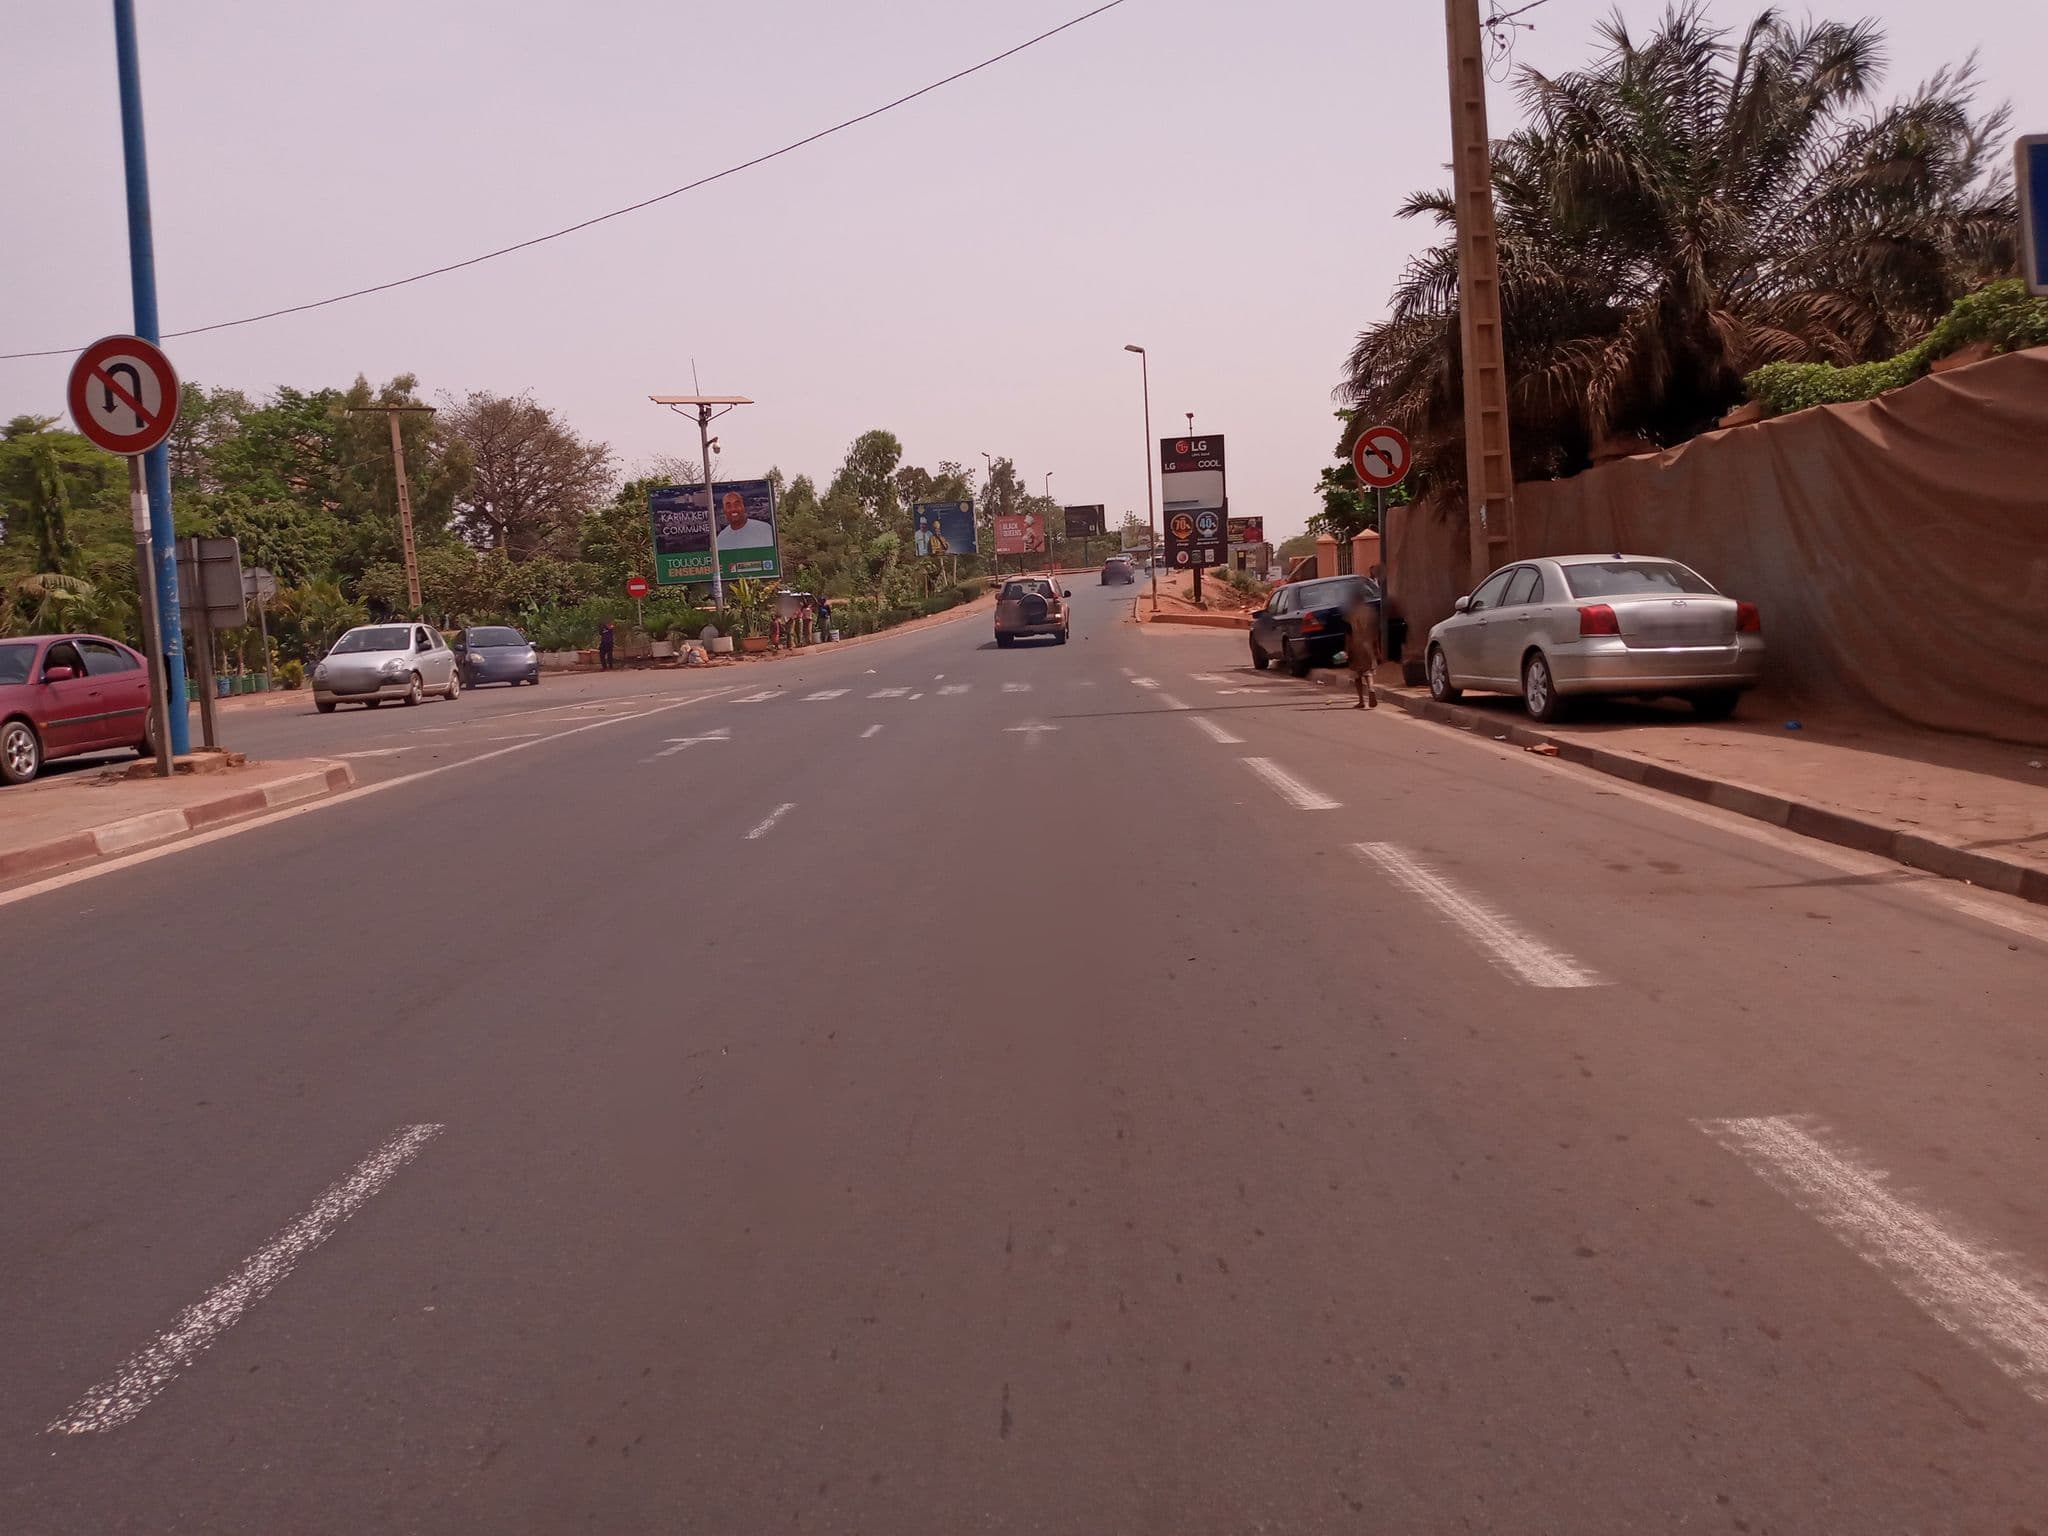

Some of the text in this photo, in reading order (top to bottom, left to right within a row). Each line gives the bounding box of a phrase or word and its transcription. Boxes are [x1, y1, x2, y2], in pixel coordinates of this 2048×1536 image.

[1191, 440, 1207, 452] LG
[1164, 459, 1222, 471] LG COOL
[691, 510, 709, 521] KEIT
[662, 523, 710, 535] COMMUNE
[666, 556, 713, 568] TOUJOUR
[668, 565, 724, 577] ENSEMBE
